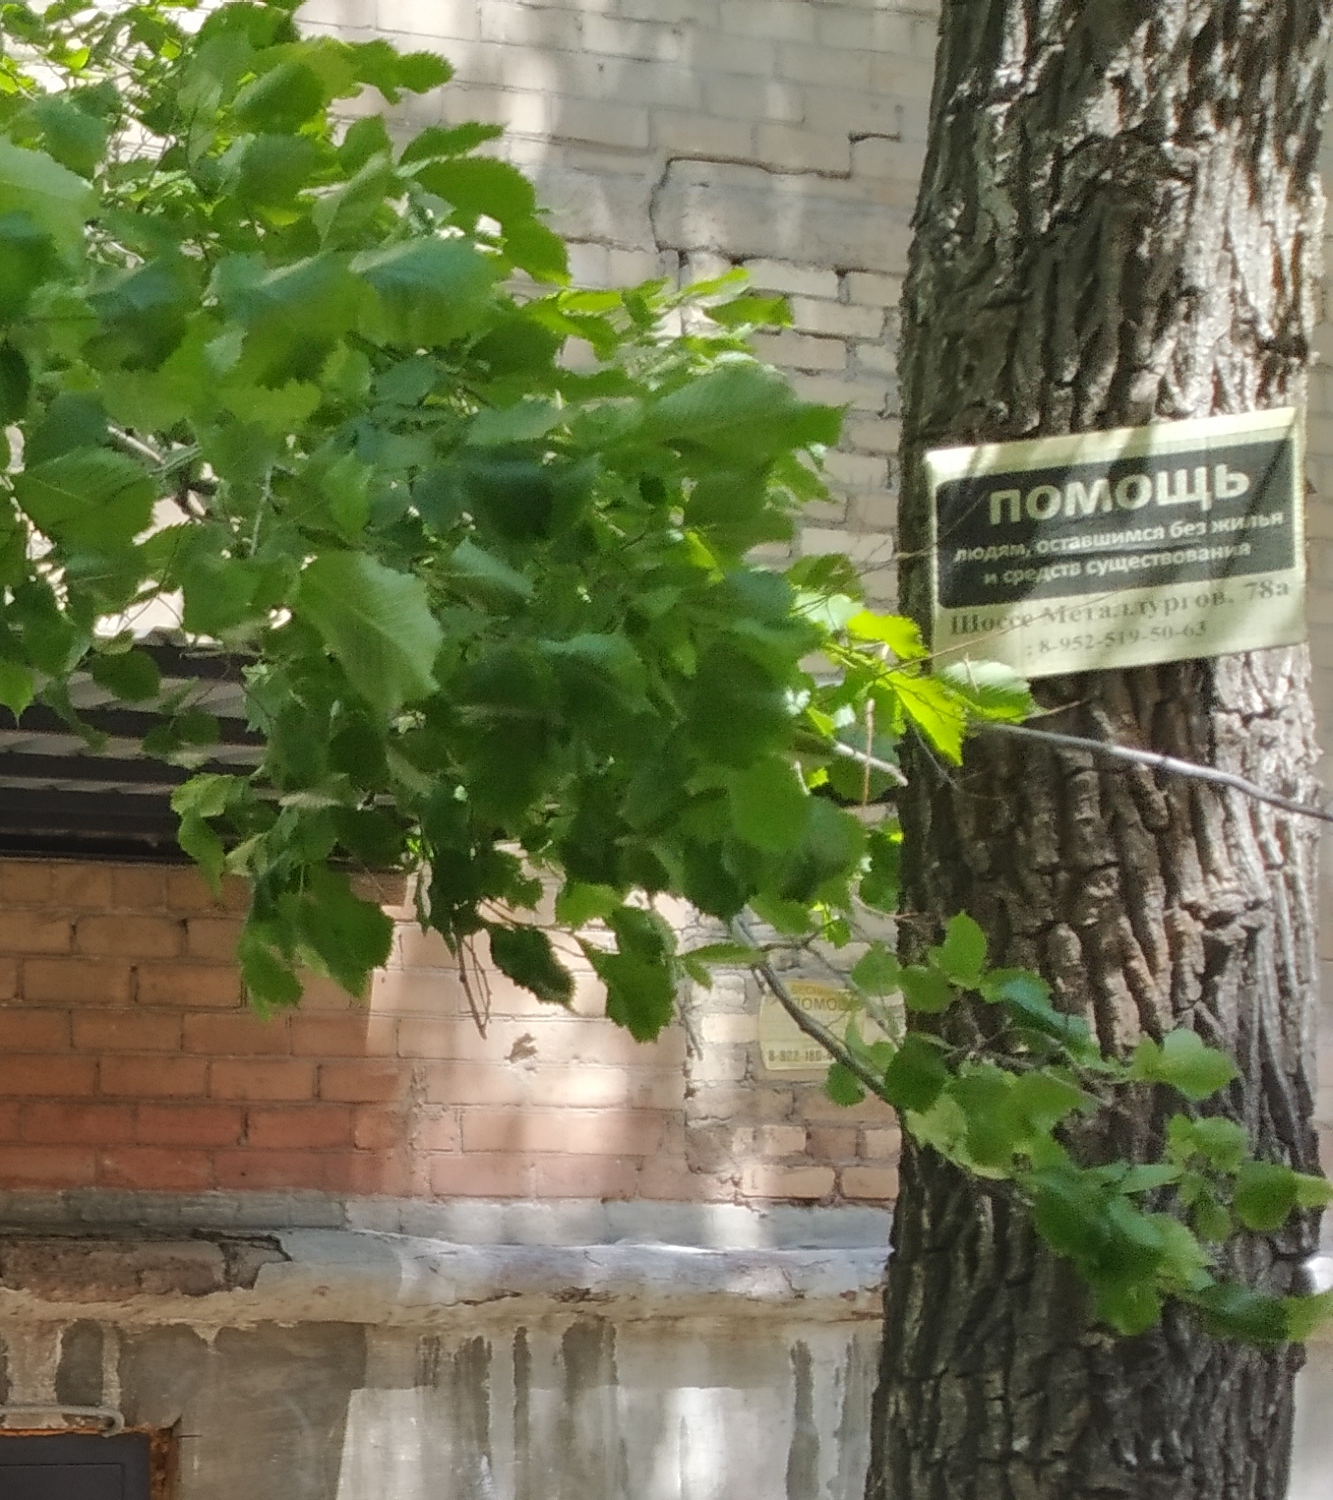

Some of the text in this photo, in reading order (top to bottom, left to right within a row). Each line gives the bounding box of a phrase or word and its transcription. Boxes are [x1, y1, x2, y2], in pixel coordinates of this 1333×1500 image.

[953, 510, 1284, 565] людям, оставшимся без жилья
[1003, 562, 1082, 587] средств
[1085, 542, 1252, 577] существования
[950, 611, 1034, 636] Шоссе
